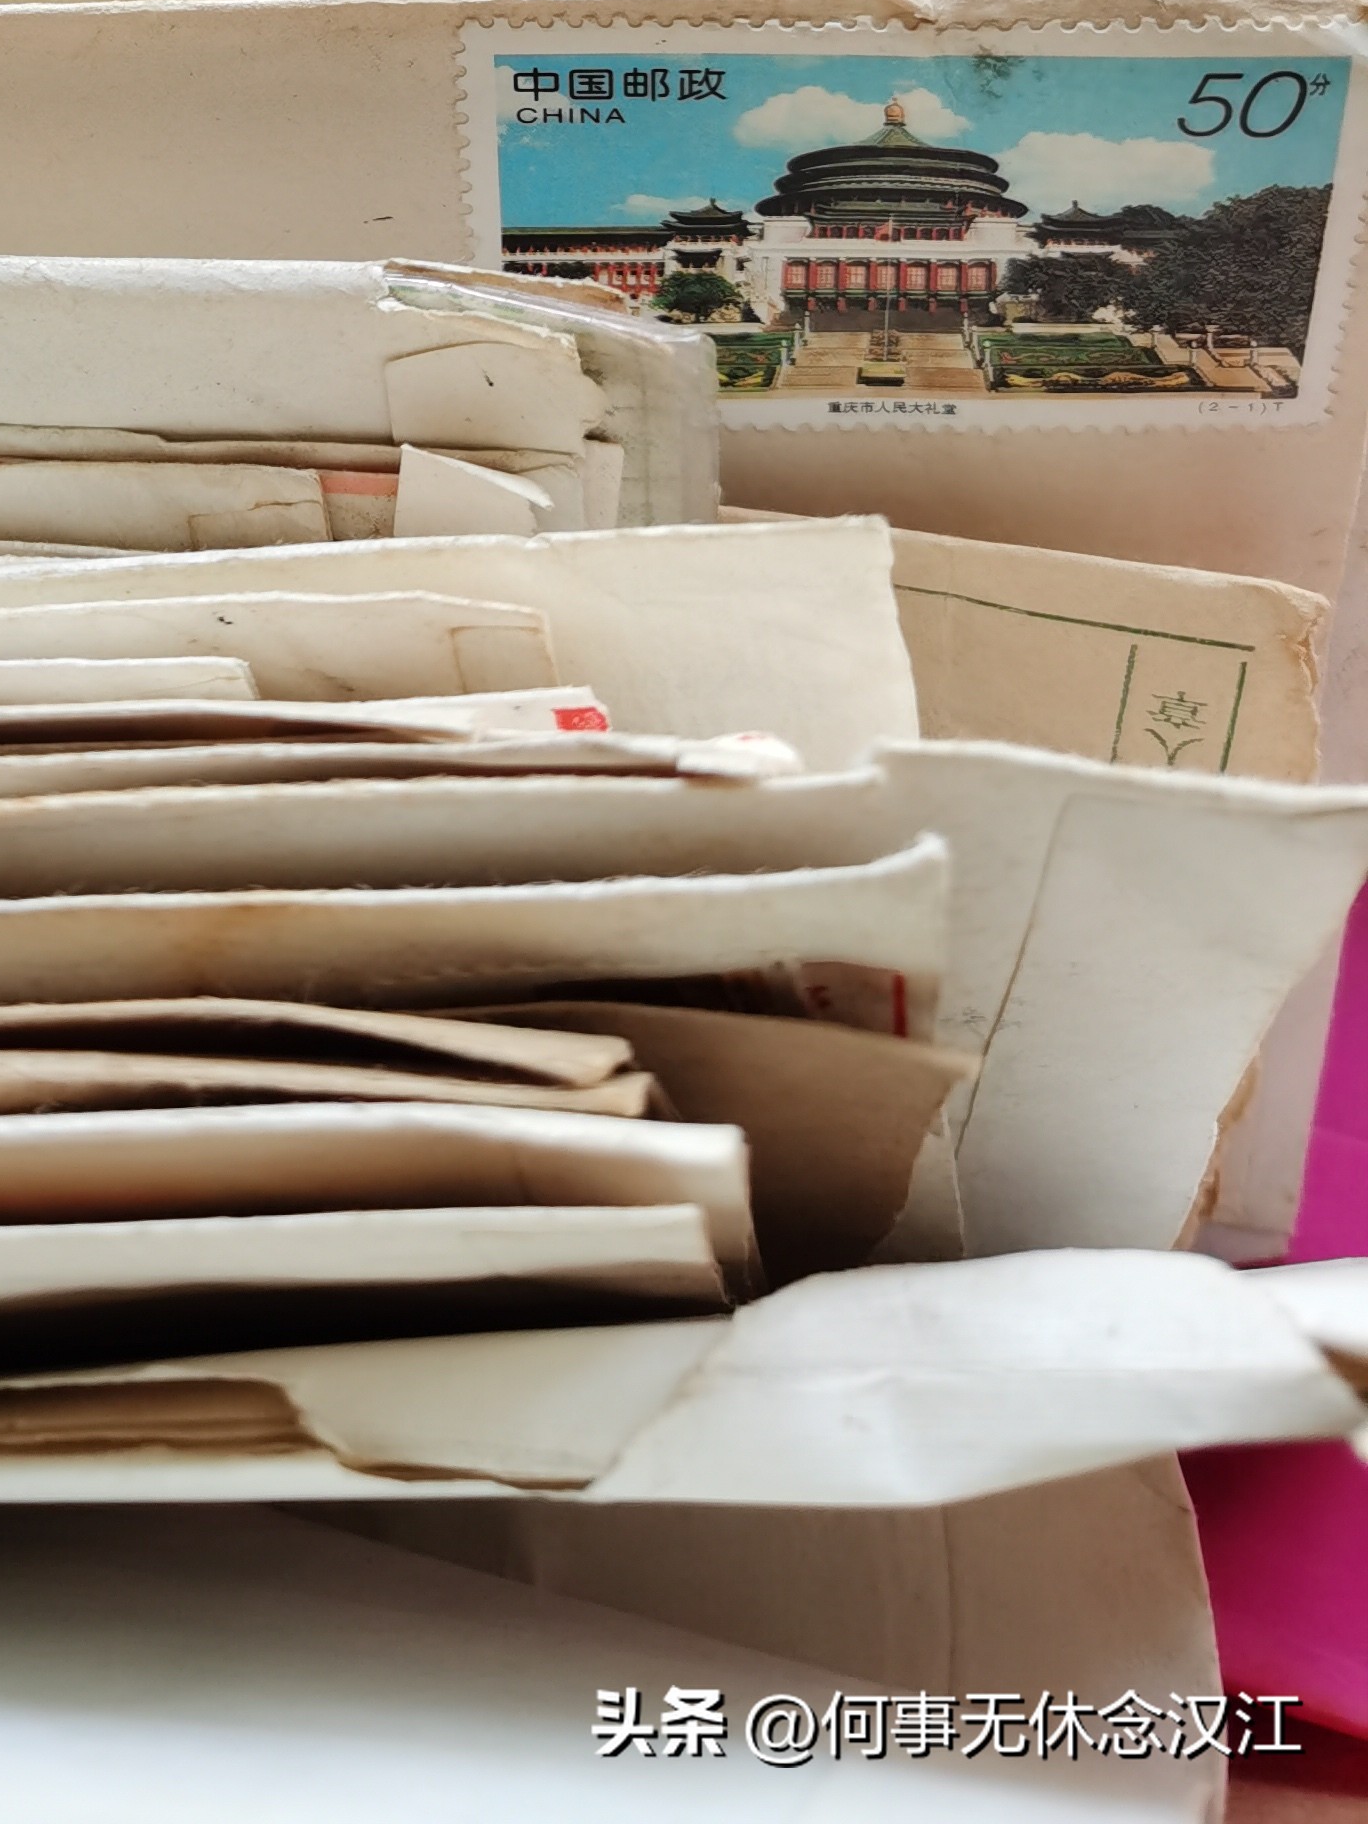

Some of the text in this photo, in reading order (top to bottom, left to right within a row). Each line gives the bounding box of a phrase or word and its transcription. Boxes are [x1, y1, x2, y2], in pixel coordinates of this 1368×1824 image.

[513, 67, 728, 102] 中国邮政
[516, 107, 626, 124] CHINA
[827, 400, 958, 415] 重庆市人民大礼堂
